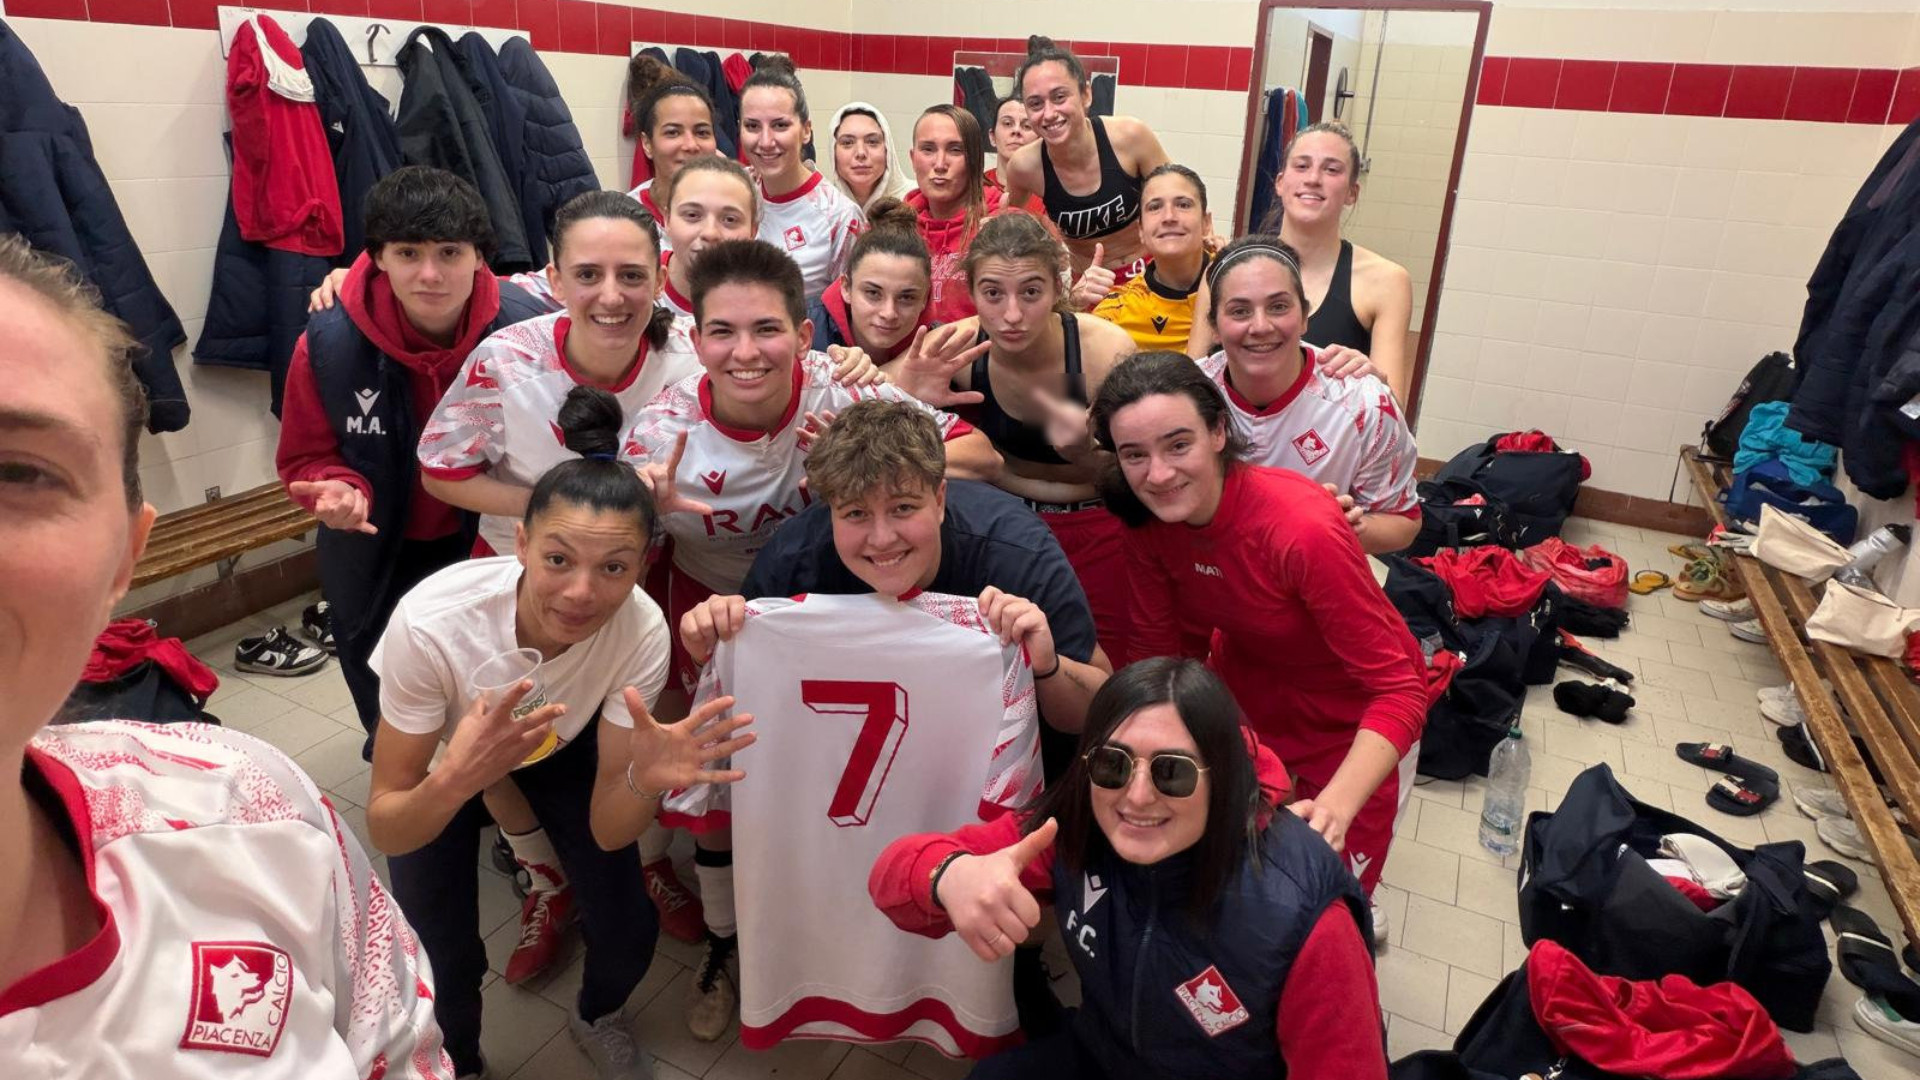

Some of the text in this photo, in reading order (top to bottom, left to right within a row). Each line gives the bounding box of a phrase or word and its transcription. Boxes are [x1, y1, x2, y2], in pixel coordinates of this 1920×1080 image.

[1058, 194, 1126, 237] NIKE
[346, 415, 387, 435] M.A.
[801, 680, 909, 828] 7
[268, 954, 288, 1026] CALCIO
[191, 1024, 271, 1049] PIACENZA
